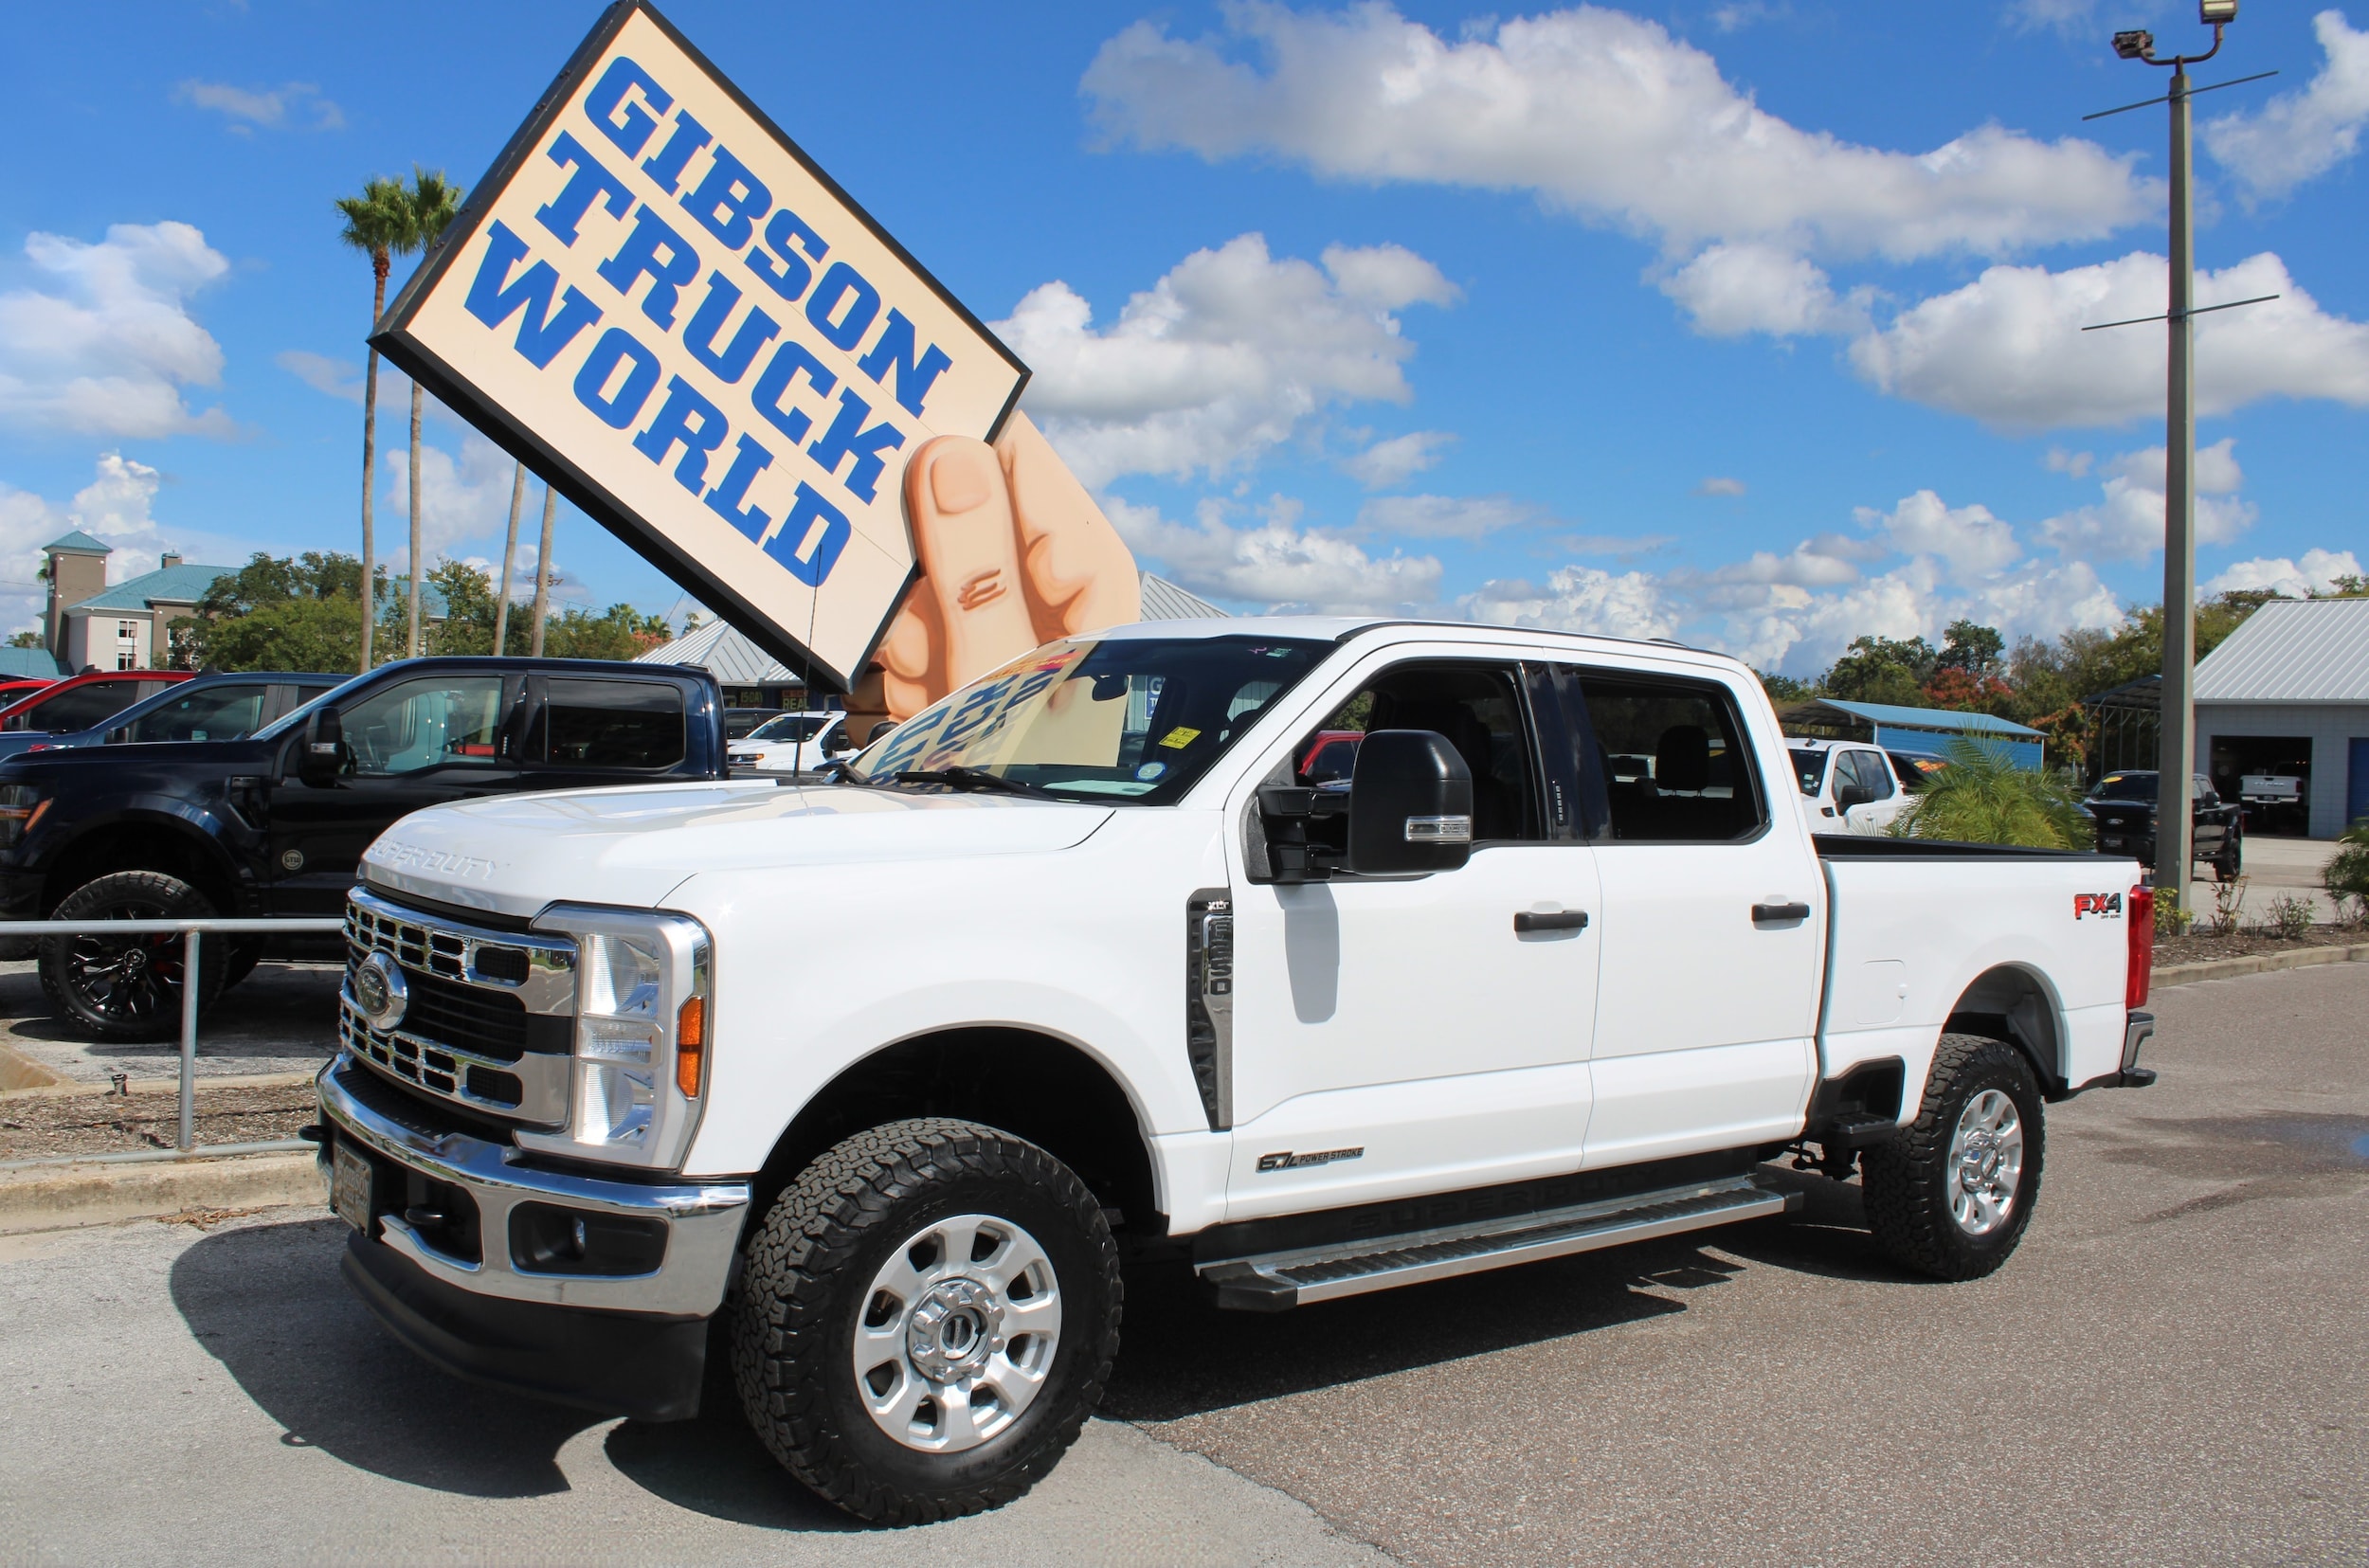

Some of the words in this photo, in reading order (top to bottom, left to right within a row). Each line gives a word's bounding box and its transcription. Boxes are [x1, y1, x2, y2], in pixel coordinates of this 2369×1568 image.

[584, 57, 952, 418] GIBSON
[534, 131, 905, 505] TRUCK
[463, 219, 851, 587] WORLD
[783, 697, 810, 710] REAL
[371, 838, 425, 867] SUPER
[422, 851, 496, 880] DUTY
[1207, 901, 1229, 910] XLT
[2074, 892, 2121, 920] FX4
[1257, 1153, 1297, 1171] 6.7L
[1299, 1152, 1330, 1163] POWER
[1330, 1147, 1365, 1160] STROKE
